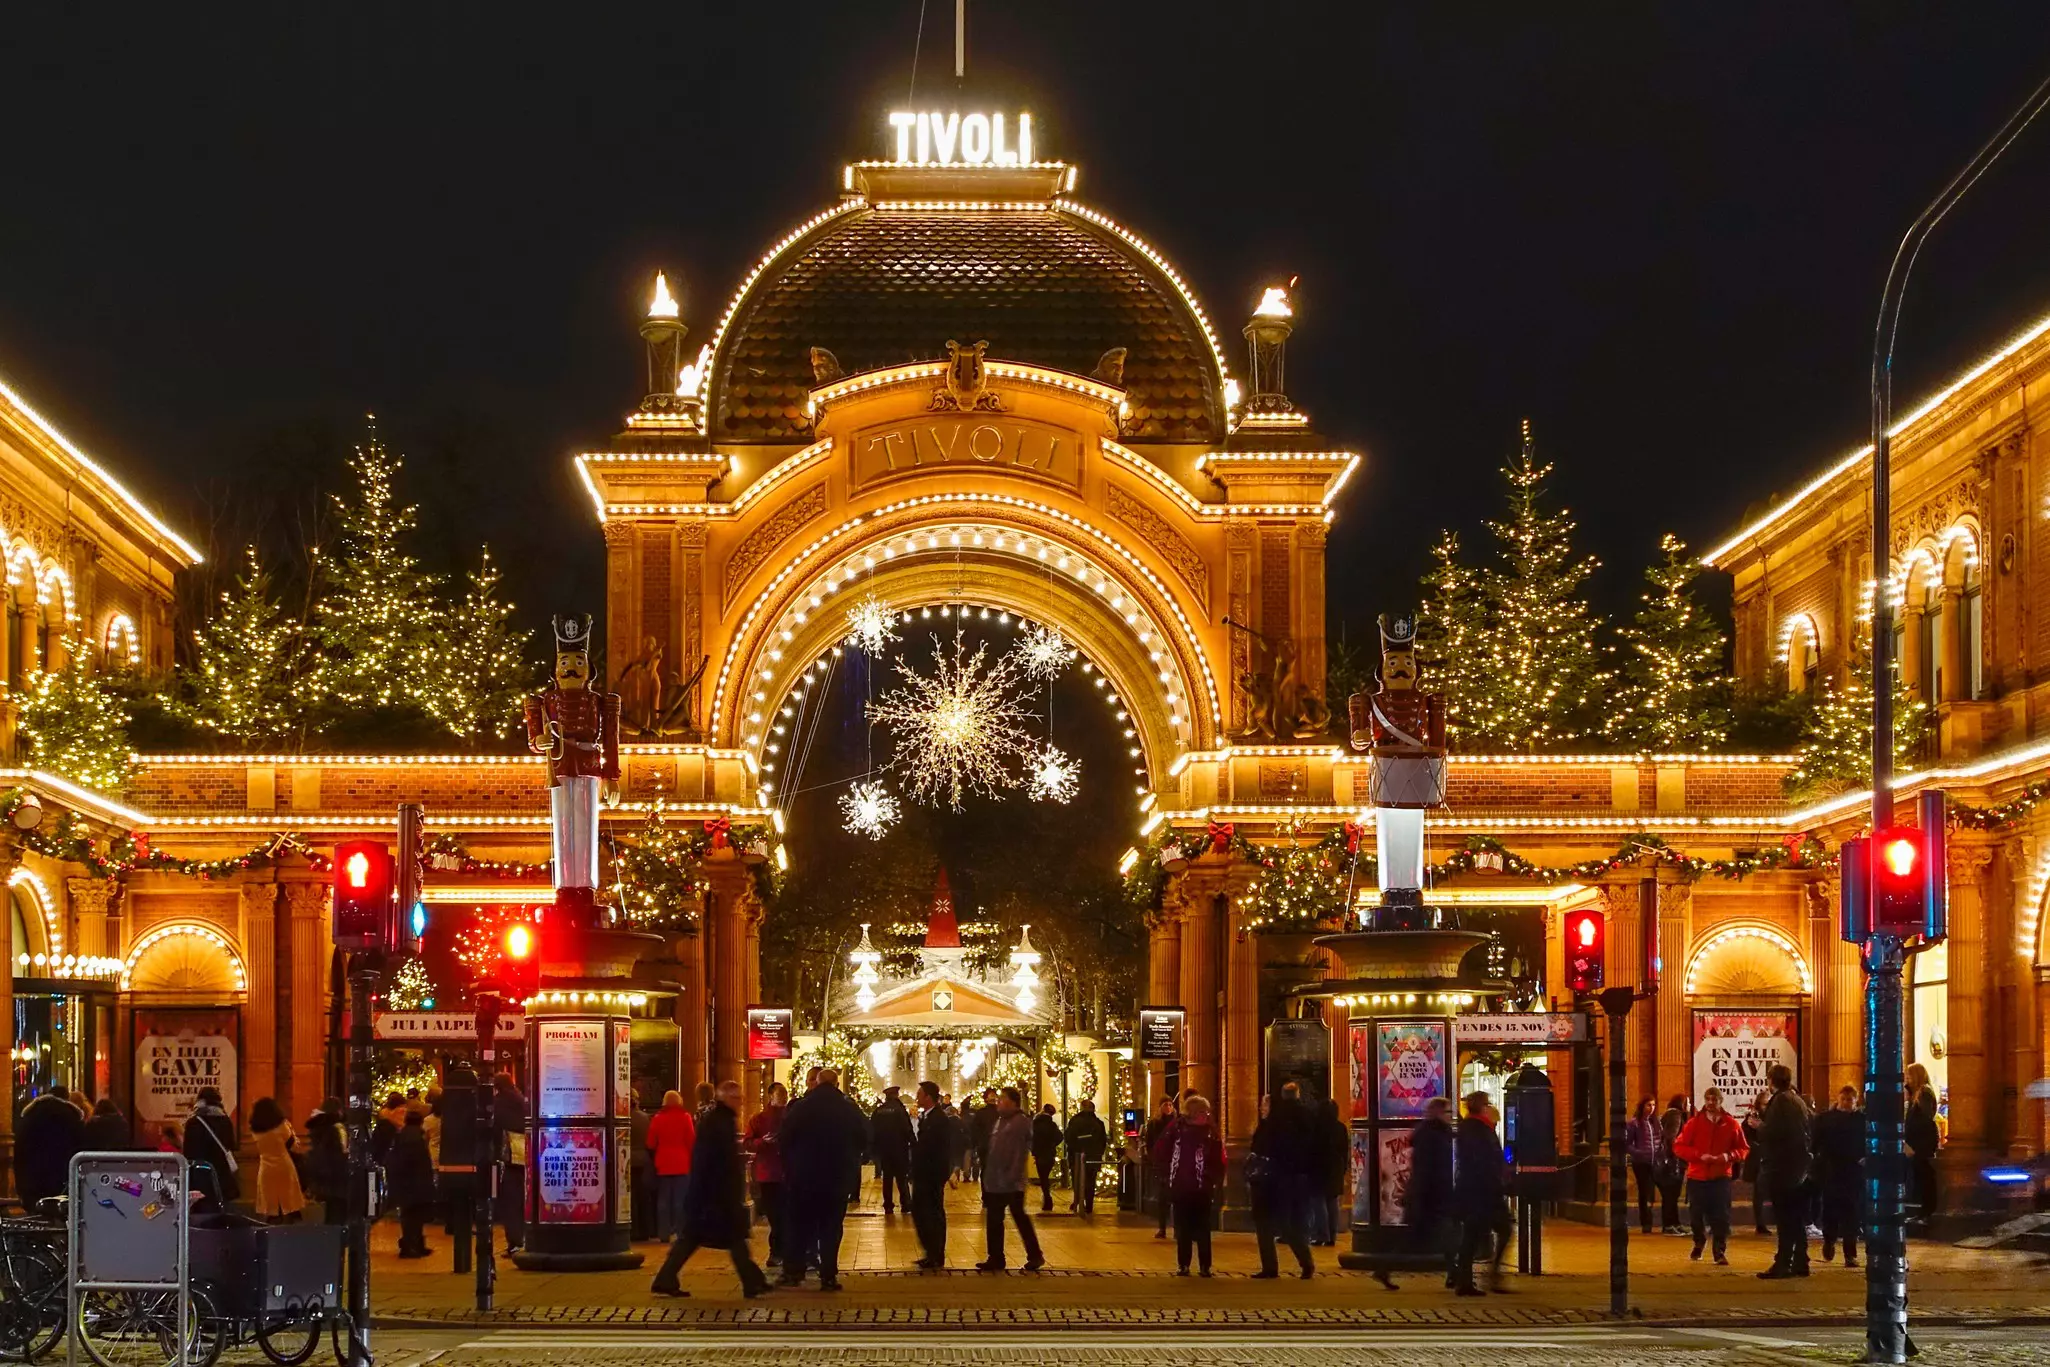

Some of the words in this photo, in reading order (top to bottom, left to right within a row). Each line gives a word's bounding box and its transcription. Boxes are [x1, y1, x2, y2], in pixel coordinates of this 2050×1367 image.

[889, 112, 1033, 164] TIVOLI
[867, 424, 1060, 472] TIVOLI
[390, 1020, 418, 1030] JUL
[422, 1020, 429, 1030] I
[432, 1020, 515, 1030] ALPEND
[1520, 1024, 1546, 1032] NOV.
[152, 1047, 172, 1057] EN
[178, 1047, 220, 1057] LILLE
[1712, 1049, 1732, 1058] EN
[1738, 1049, 1780, 1058] LILLE
[152, 1058, 220, 1076] GAVE
[544, 1162, 568, 1171] FOR
